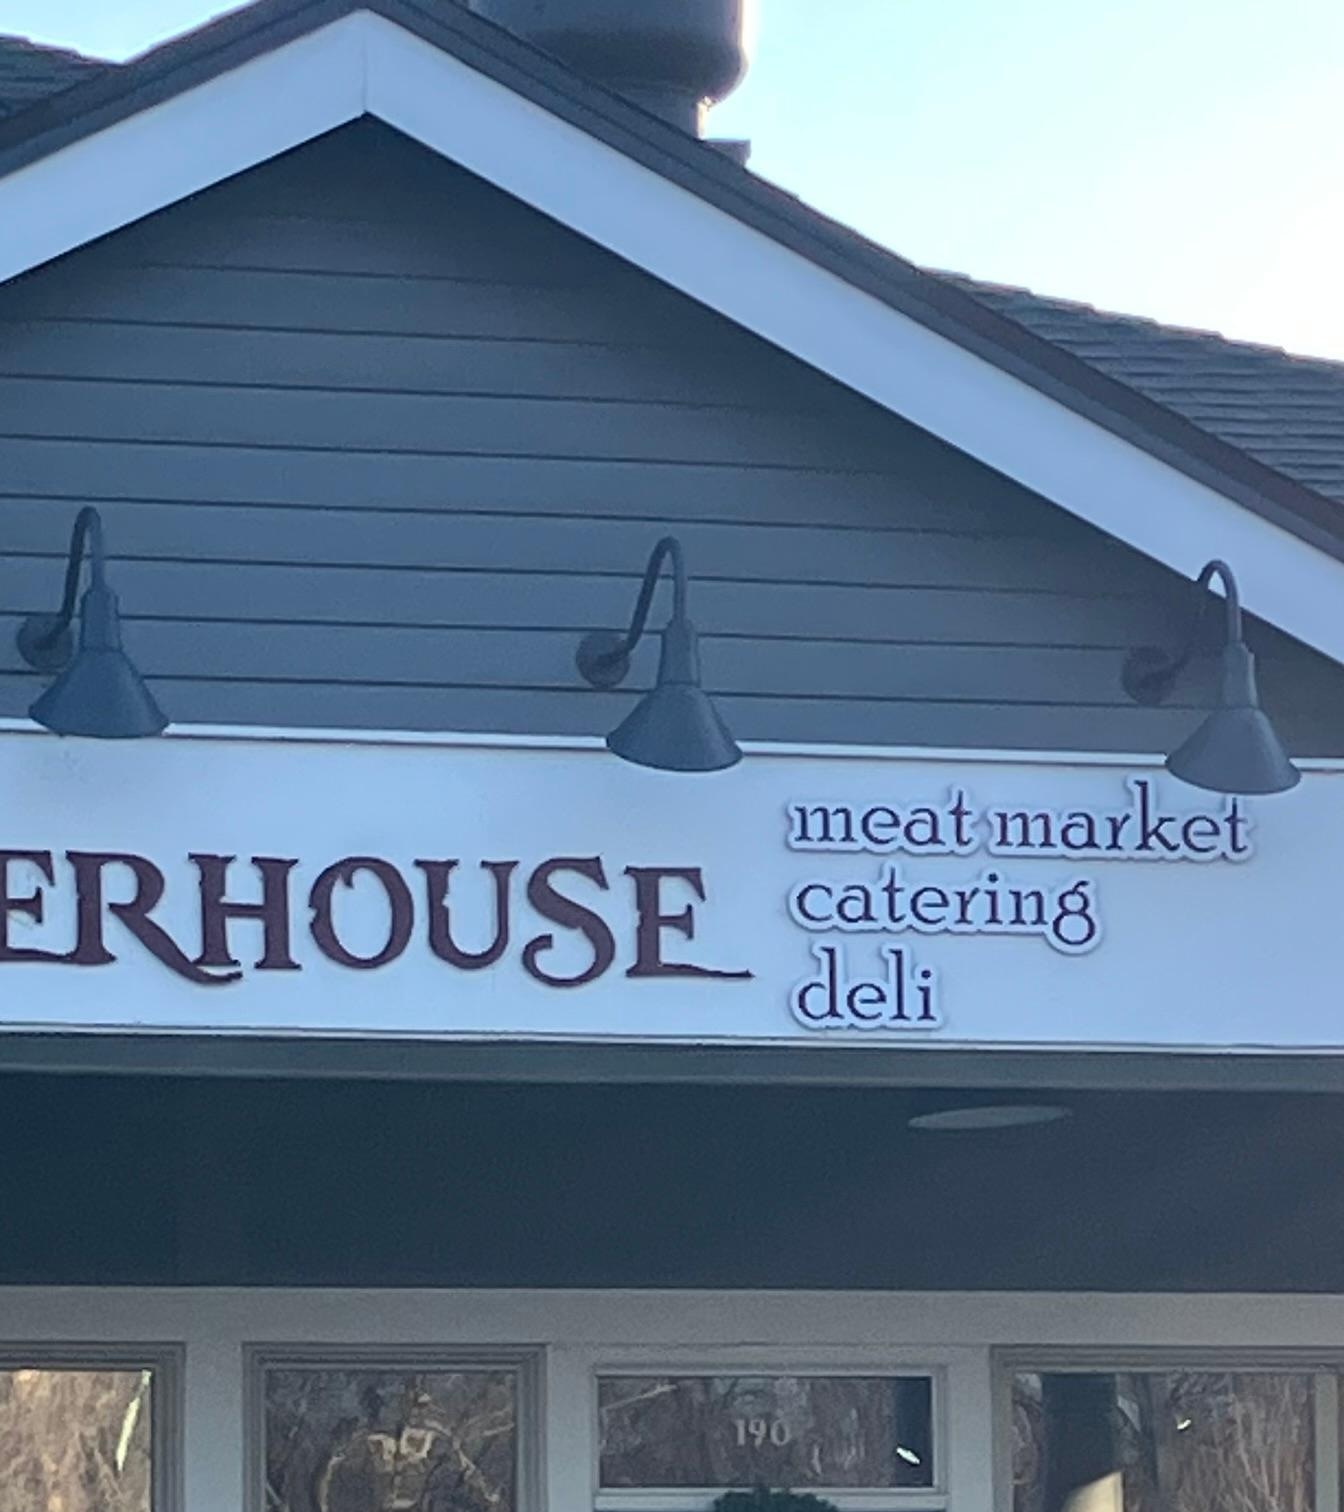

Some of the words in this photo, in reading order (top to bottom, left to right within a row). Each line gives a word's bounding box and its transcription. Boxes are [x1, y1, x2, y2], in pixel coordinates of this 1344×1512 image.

[792, 790, 974, 847] meat
[993, 780, 1249, 854] market
[795, 866, 1095, 947] catering
[796, 947, 937, 1022] deli
[735, 1418, 792, 1451] 190
